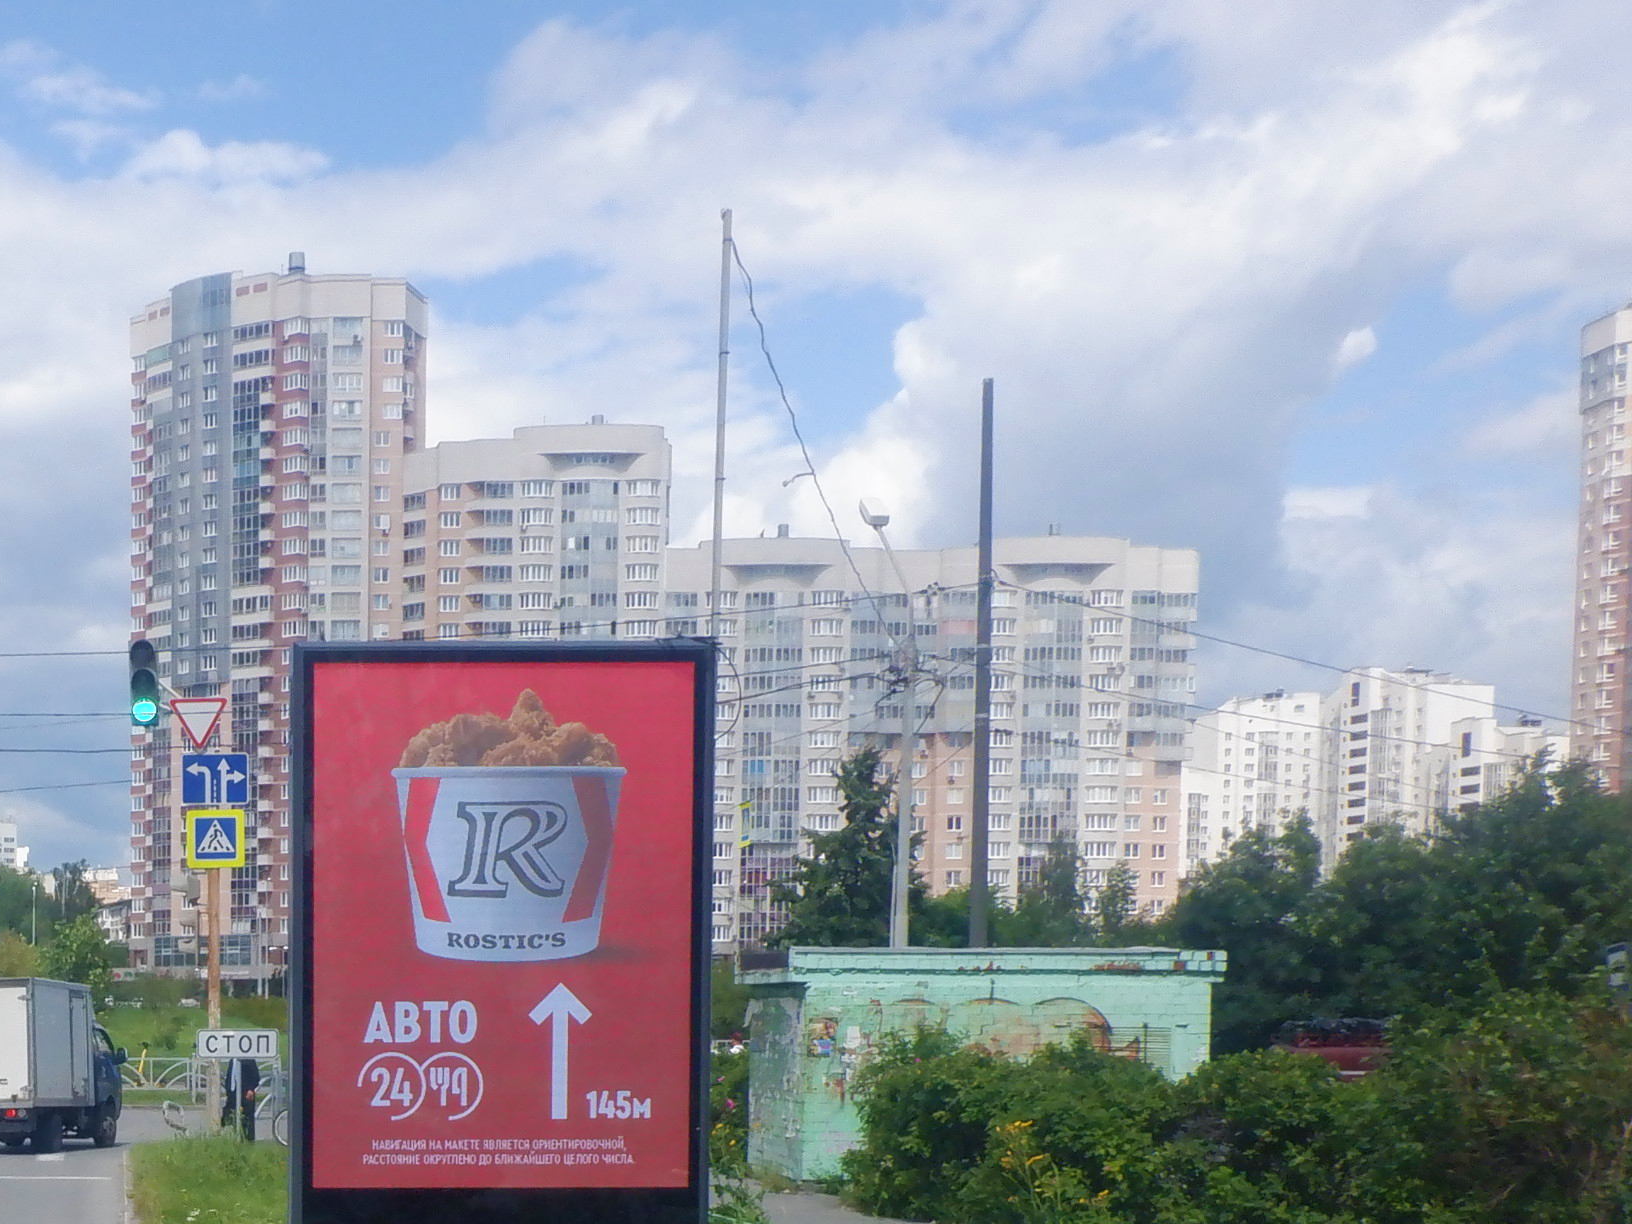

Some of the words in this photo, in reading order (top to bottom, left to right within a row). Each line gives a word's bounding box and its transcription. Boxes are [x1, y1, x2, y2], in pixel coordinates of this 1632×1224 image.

[447, 801, 568, 899] R
[447, 932, 566, 949] ROSTIC'S
[364, 1000, 478, 1044] АВТО
[206, 1034, 270, 1054] СТОП
[371, 1067, 413, 1107] 24
[372, 1139, 426, 1151] НАВИГАЦИЯ
[429, 1139, 442, 1151] НА
[444, 1139, 480, 1151] МАКЕТЕ
[483, 1139, 530, 1151] ЯВЛЯЕТСЯ
[532, 1136, 626, 1152] ОРИЕНТИРОВОЧНОЙ,
[363, 1154, 420, 1165] РАССТОЯНИЕ
[423, 1154, 477, 1165] ОКРУГЛЕНО
[478, 1154, 492, 1166] ДО
[494, 1151, 561, 1165] БЛИЖАЙШЕГО
[563, 1154, 599, 1166] ЦЕЛОГО
